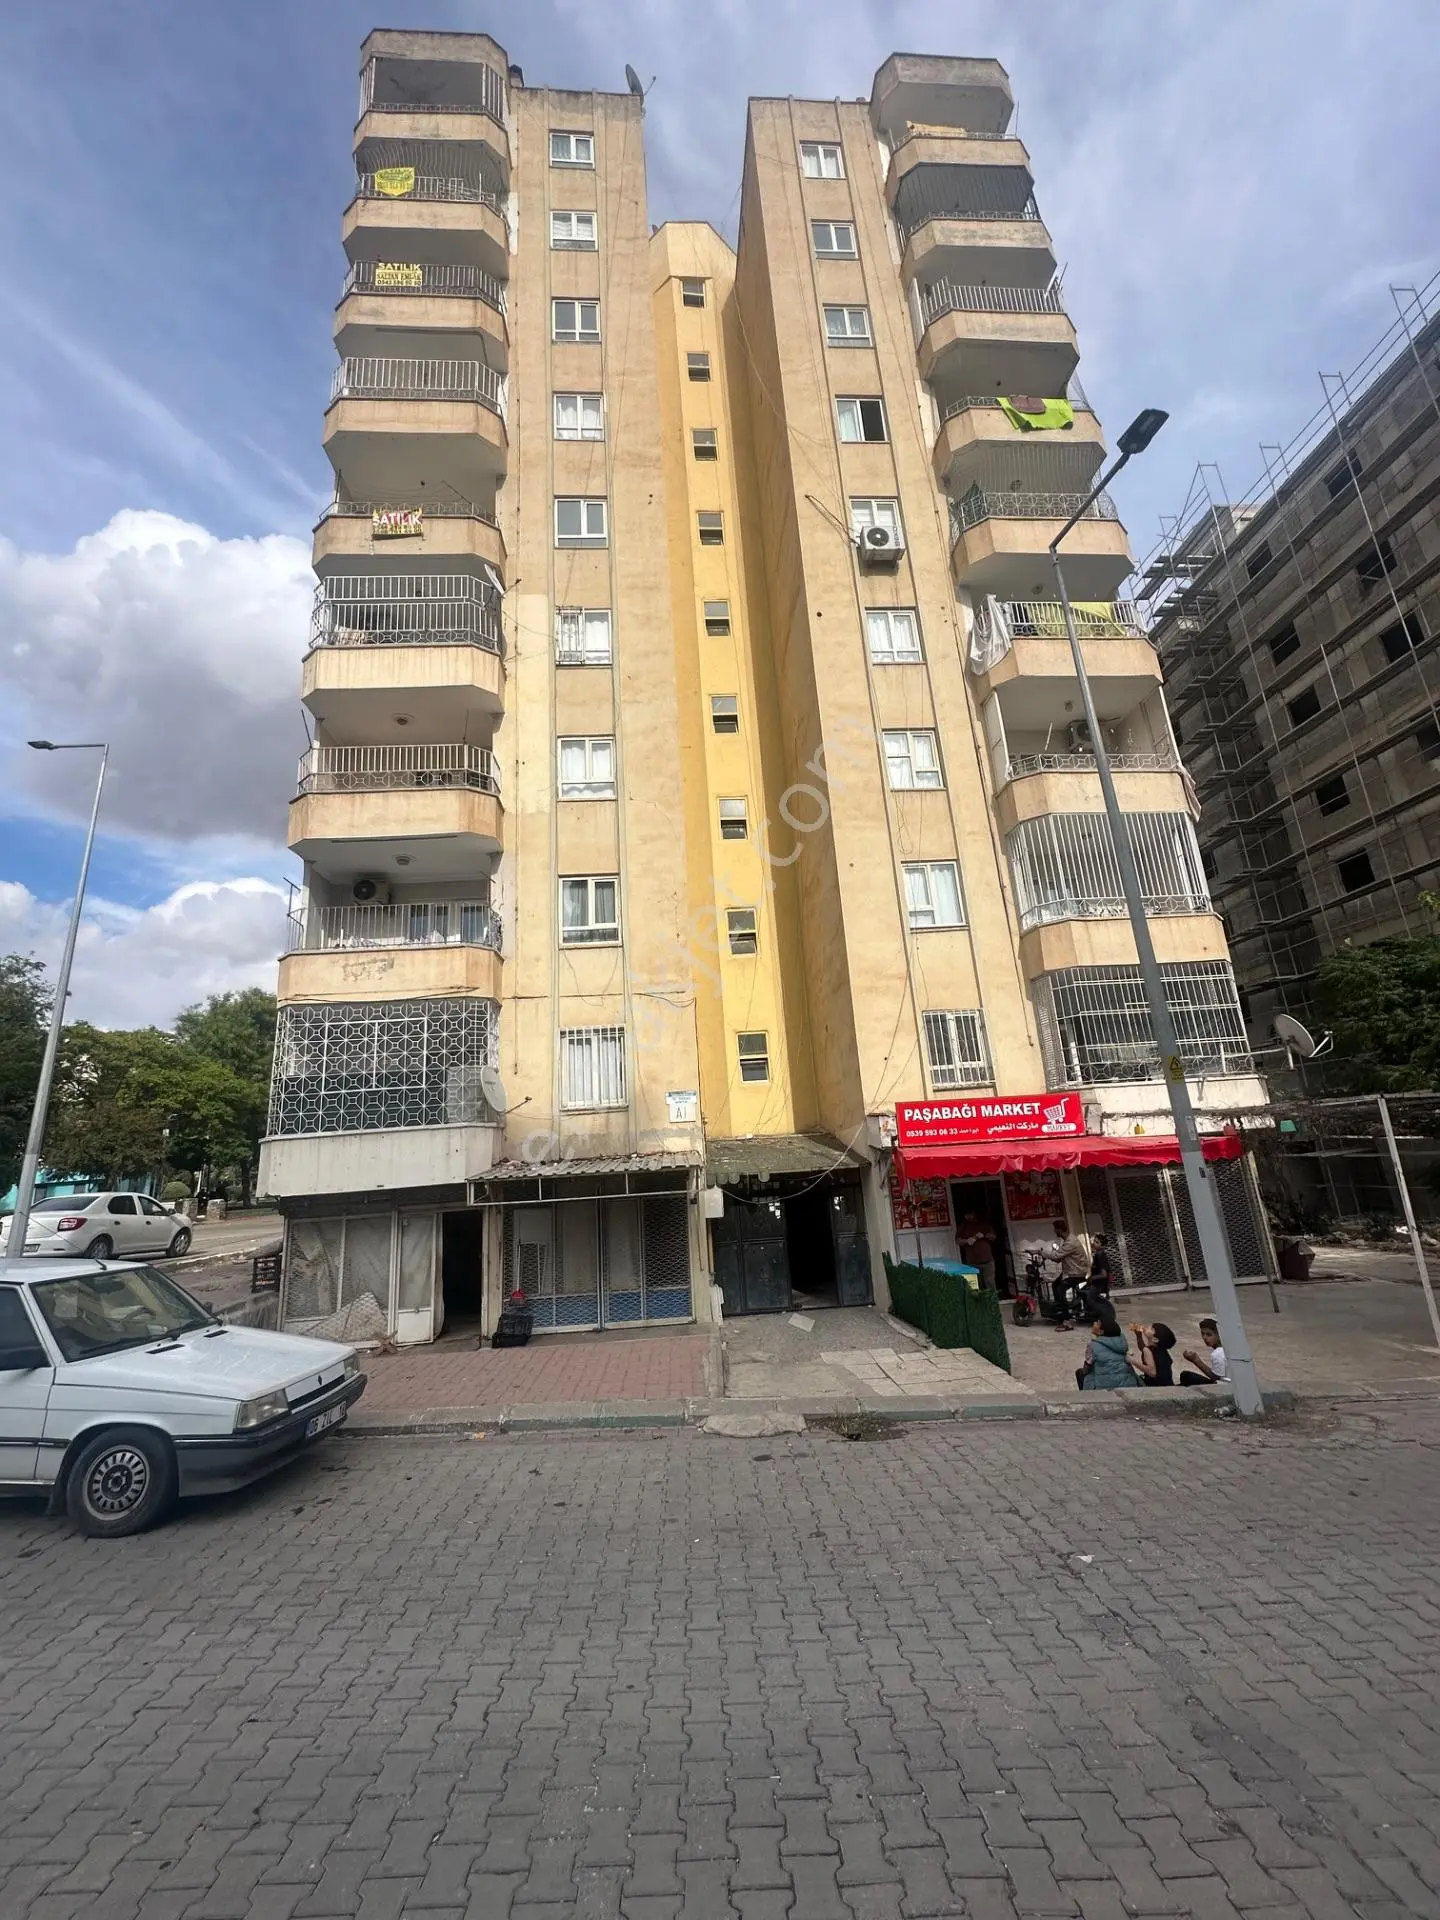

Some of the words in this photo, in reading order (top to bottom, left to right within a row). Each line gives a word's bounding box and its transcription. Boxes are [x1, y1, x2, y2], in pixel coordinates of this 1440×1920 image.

[378, 262, 421, 271] SATILIK
[372, 510, 422, 526] SATILIK
[904, 1103, 977, 1123] PAŞABAĞI
[980, 1102, 1041, 1117] MARKET
